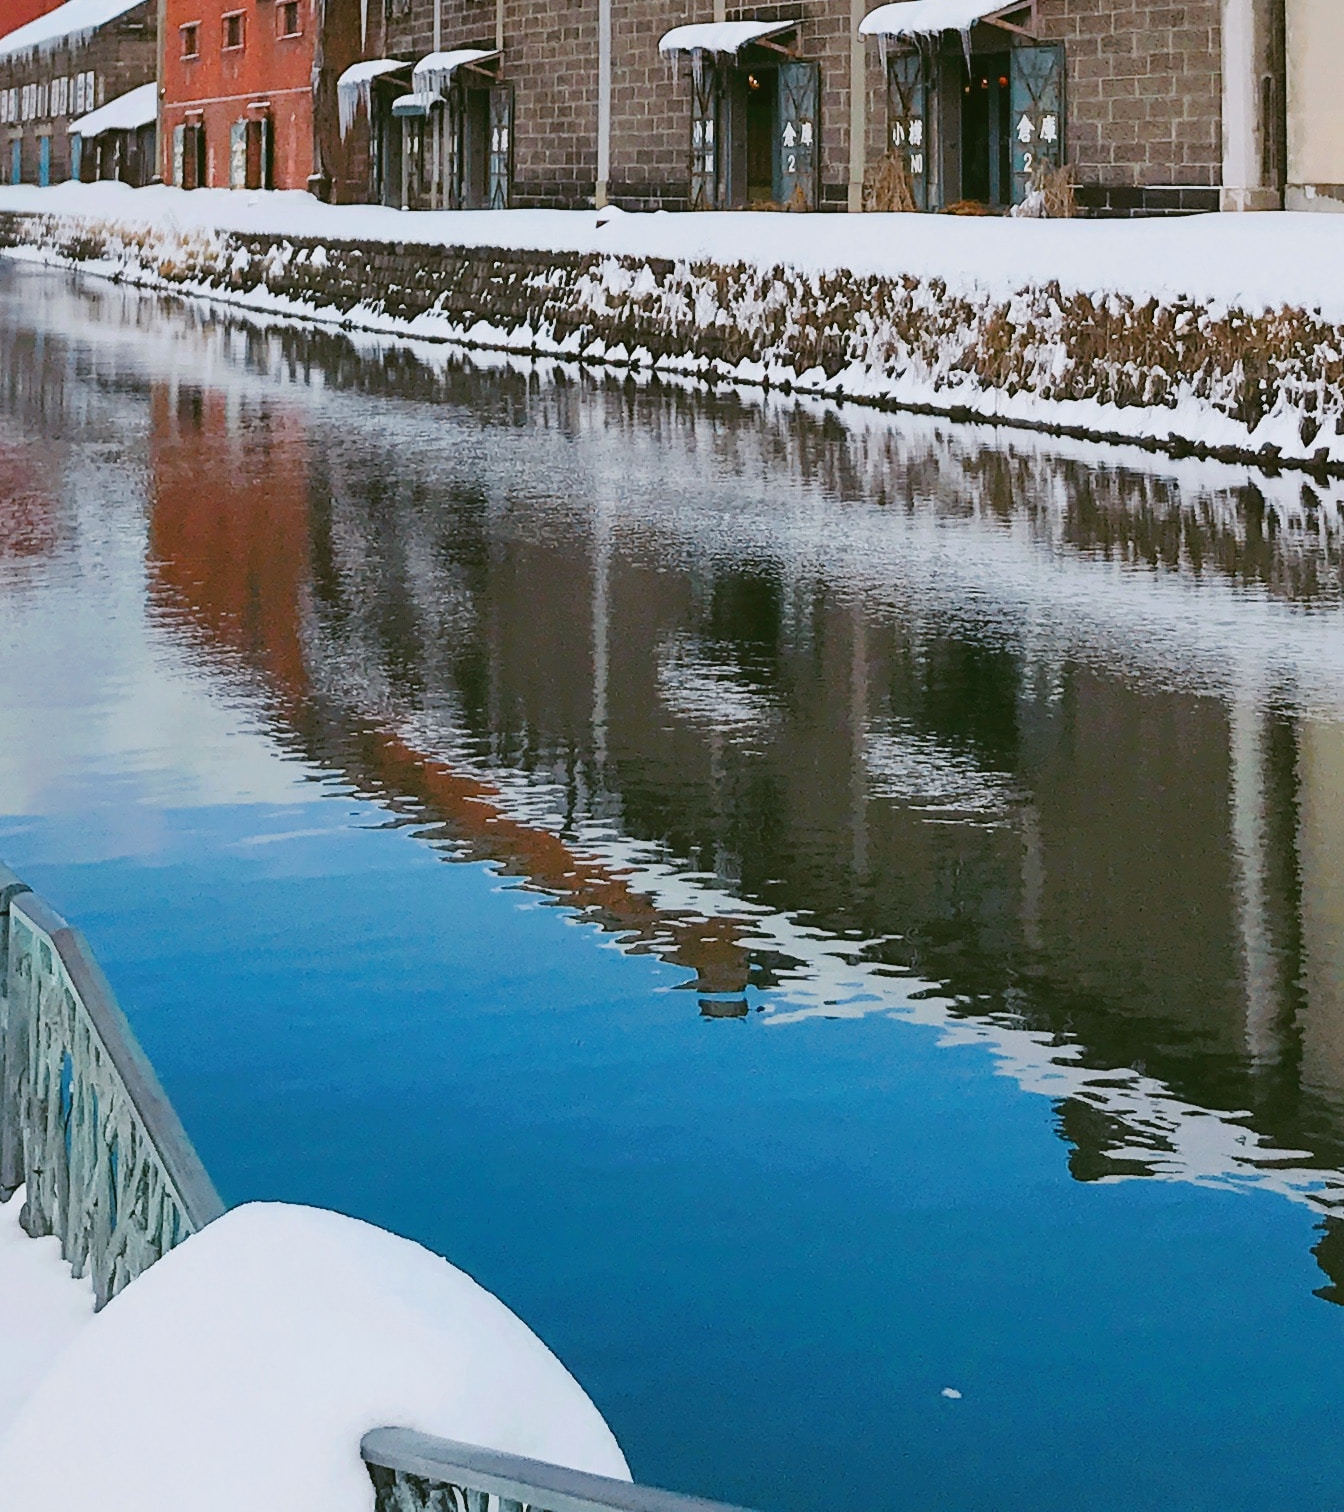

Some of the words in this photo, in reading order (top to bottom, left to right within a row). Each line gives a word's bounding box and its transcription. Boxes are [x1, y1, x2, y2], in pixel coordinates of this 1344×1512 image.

[1017, 114, 1057, 143] 倉庫
[788, 155, 795, 173] 2
[1023, 153, 1032, 172] 2
